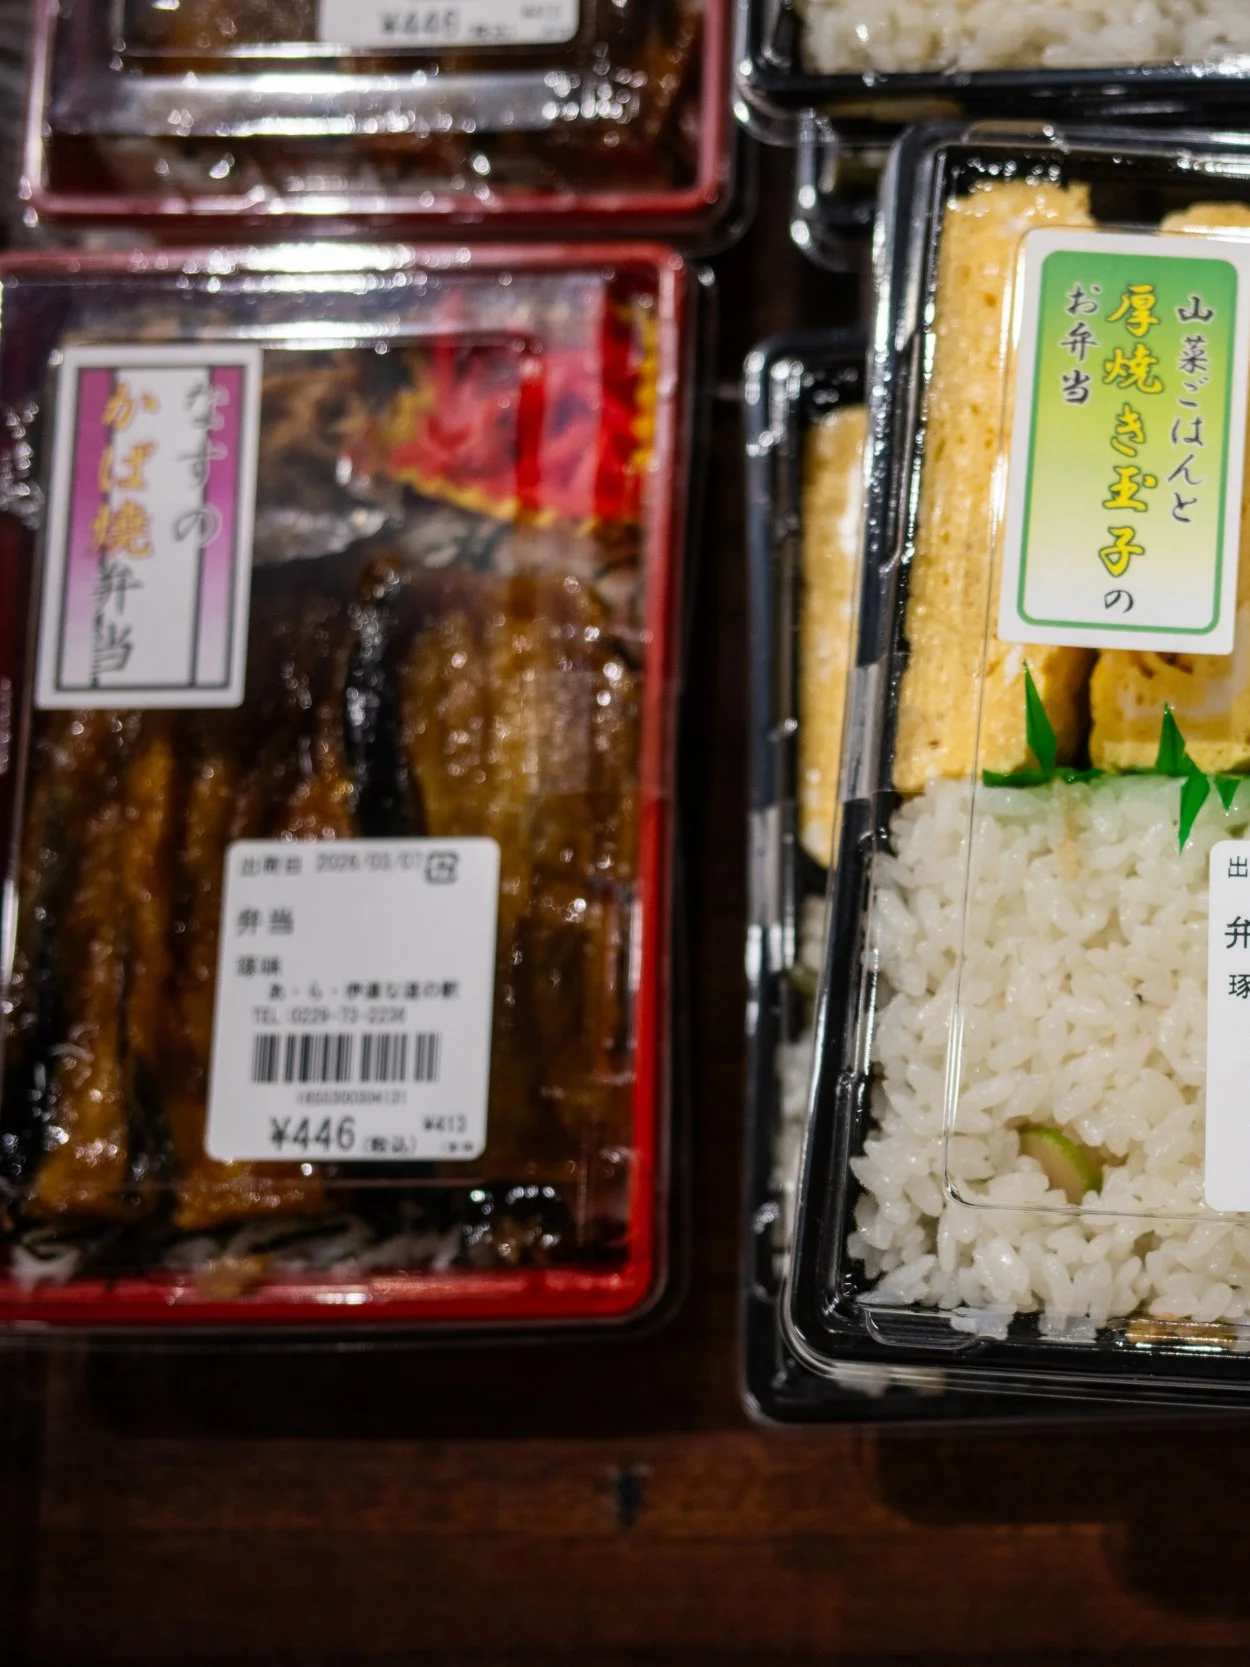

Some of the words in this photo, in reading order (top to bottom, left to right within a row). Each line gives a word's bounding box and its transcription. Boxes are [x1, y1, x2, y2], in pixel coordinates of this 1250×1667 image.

[1059, 282, 1101, 406] お弁当
[1167, 295, 1214, 523] 山菜ごはんと
[171, 384, 230, 550] なすの
[1099, 283, 1165, 614] 厚焼き玉子の
[237, 908, 295, 937] 弁当
[269, 1115, 357, 1153] ¥446
